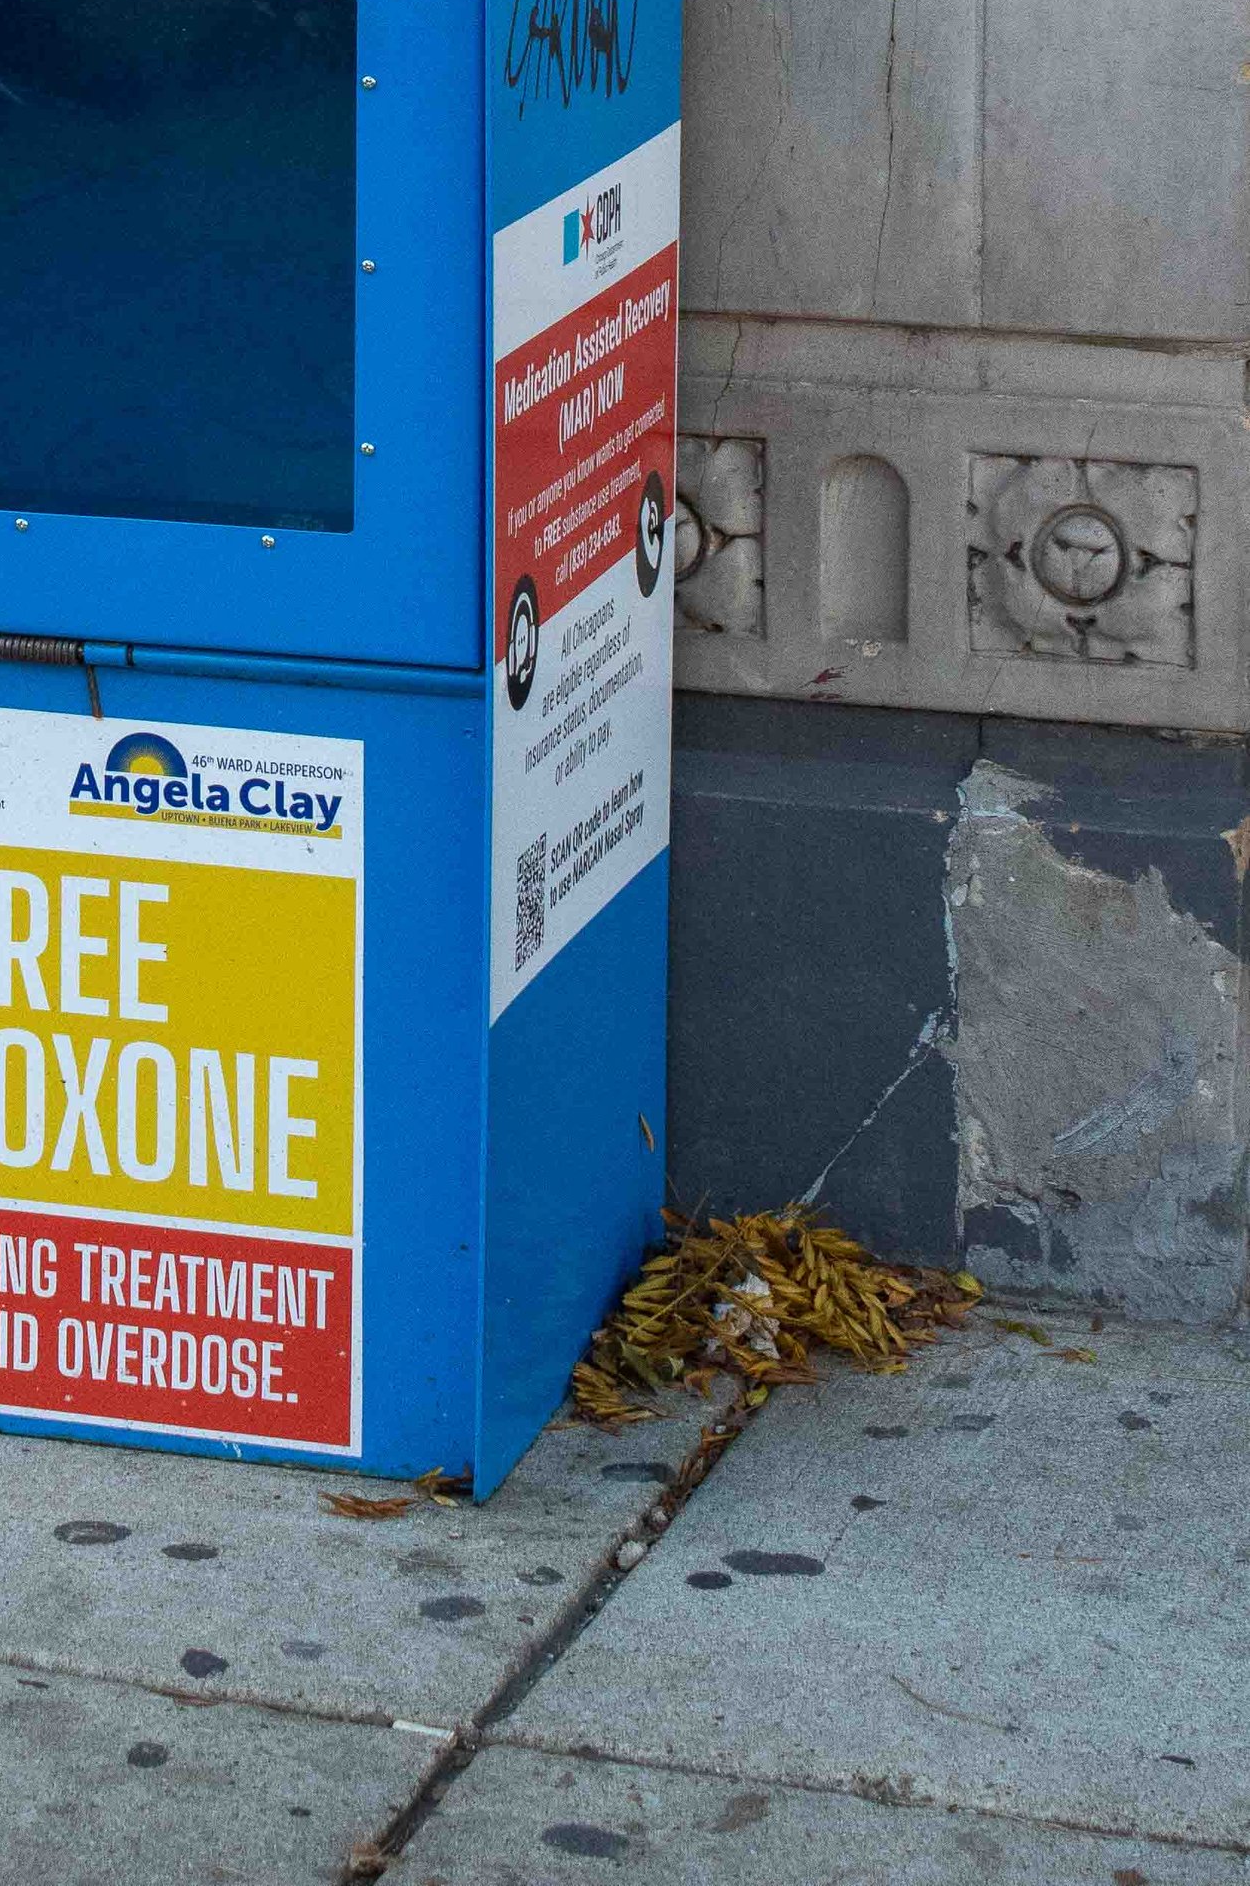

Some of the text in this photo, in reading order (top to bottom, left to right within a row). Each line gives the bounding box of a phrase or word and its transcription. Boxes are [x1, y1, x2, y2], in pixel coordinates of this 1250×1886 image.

[596, 183, 622, 245] CDPH
[504, 280, 670, 424] Medication Assisted Recovery
[558, 363, 624, 450] (MAR) NOW
[507, 506, 513, 536] If
[513, 504, 527, 538] you
[527, 497, 536, 519] or
[536, 478, 562, 513] anyone
[562, 467, 576, 500] you
[576, 453, 595, 483] know
[615, 431, 623, 452] to
[534, 535, 542, 559] to
[543, 515, 561, 552] FREE
[597, 484, 609, 509] use
[555, 552, 568, 585] call
[541, 614, 630, 717] are eligible regardless of
[560, 626, 571, 661] All
[216, 757, 252, 772] WARD
[255, 760, 342, 780] ALDERPERSON
[525, 723, 561, 774] insurance
[554, 761, 563, 786] or
[564, 739, 587, 777] ability
[588, 731, 596, 755] to
[70, 762, 343, 832] Angela Clay
[161, 811, 312, 834] UPTOWN BUENA PARK LAKEVIEW
[550, 832, 571, 873] SCAN
[572, 821, 583, 853] QR
[584, 806, 601, 841] code
[602, 800, 609, 823] to
[610, 783, 628, 815] learn
[549, 801, 644, 909] to use NARCAN Nasal Spray
[73, 1242, 334, 1329] TREATMENT
[57, 1317, 297, 1403] OVERDOSE.
